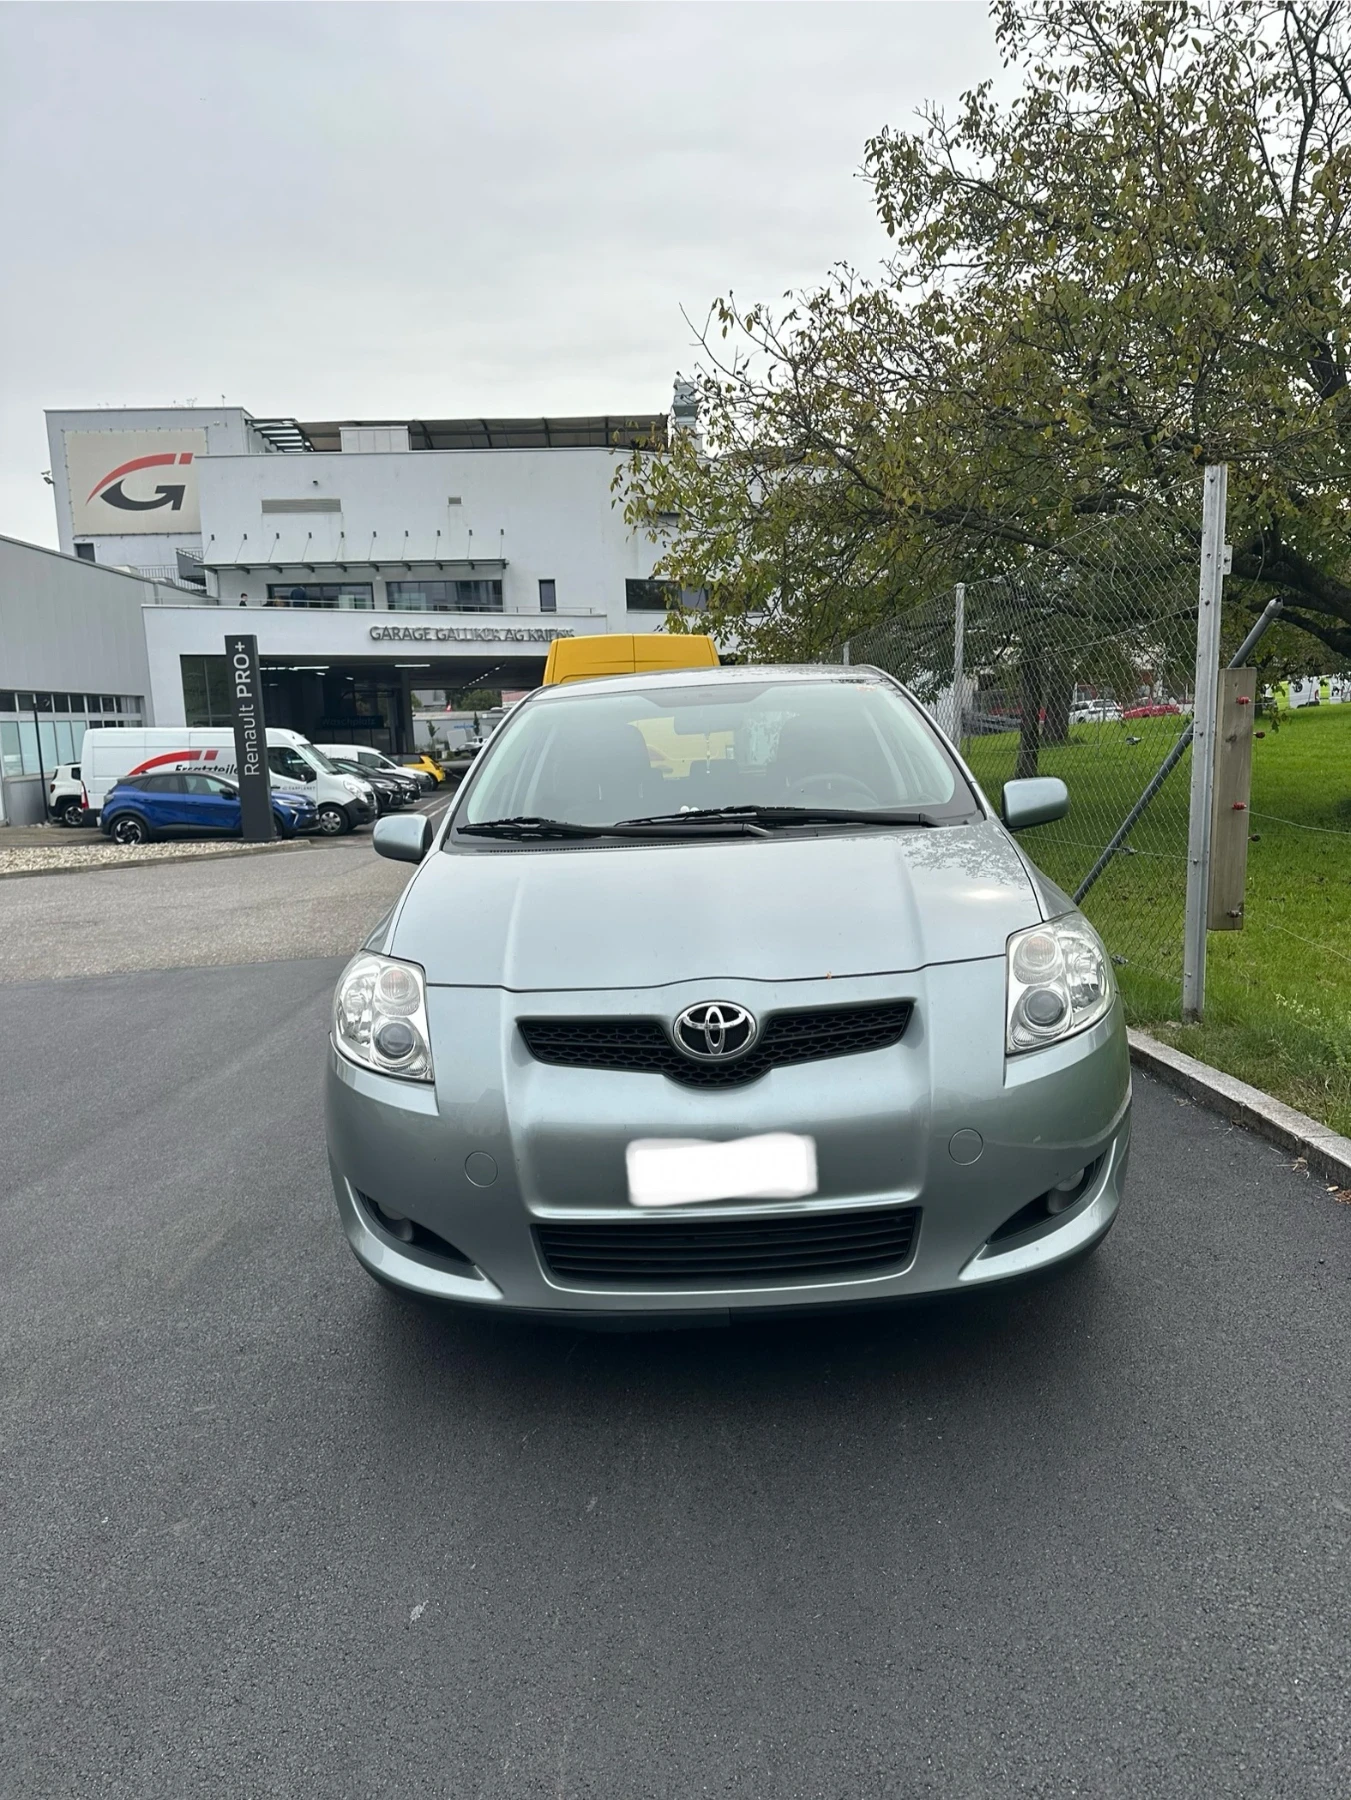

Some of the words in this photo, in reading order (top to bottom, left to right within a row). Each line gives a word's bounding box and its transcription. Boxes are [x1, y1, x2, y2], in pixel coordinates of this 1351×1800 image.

[369, 626, 432, 640] GARAGE
[505, 628, 525, 641] AG
[233, 641, 252, 698] PRO+
[238, 704, 260, 776] Renault
